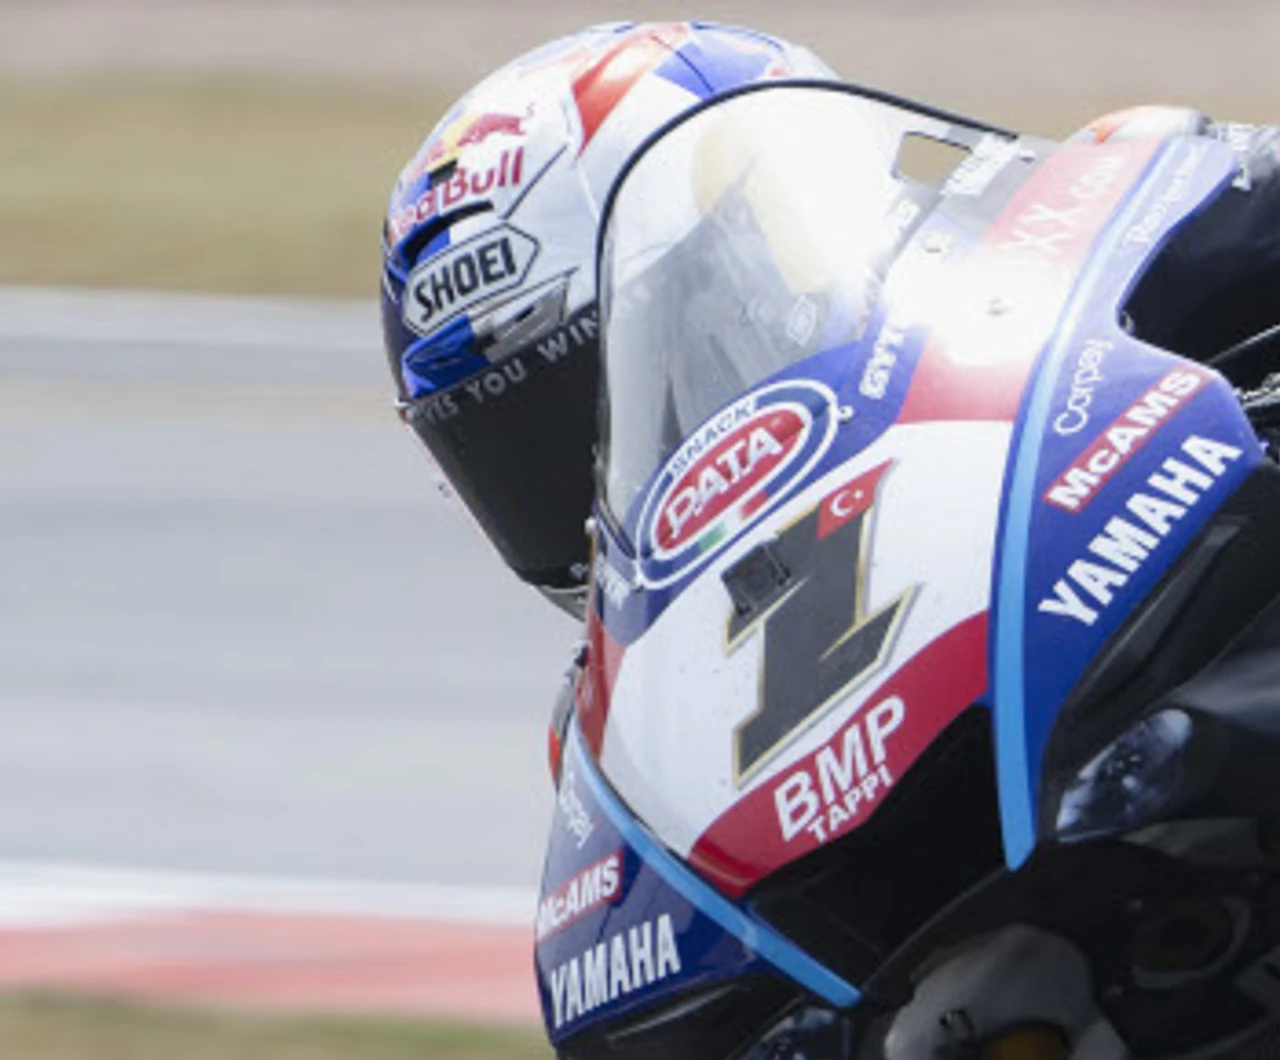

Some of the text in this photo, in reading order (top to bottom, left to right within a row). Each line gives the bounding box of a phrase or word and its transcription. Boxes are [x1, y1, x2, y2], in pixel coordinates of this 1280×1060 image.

[444, 146, 525, 201] Bull
[414, 237, 518, 323] SHOEI
[466, 359, 527, 399] YOU
[666, 424, 783, 537] PATA
[1048, 369, 1201, 512] McAMS
[1039, 434, 1242, 627] YAMAHA
[721, 504, 924, 788] 1
[774, 696, 904, 842] BMP
[807, 765, 891, 843] TAPPI
[535, 853, 619, 938] McAMS
[549, 914, 681, 1030] YAMAHA
